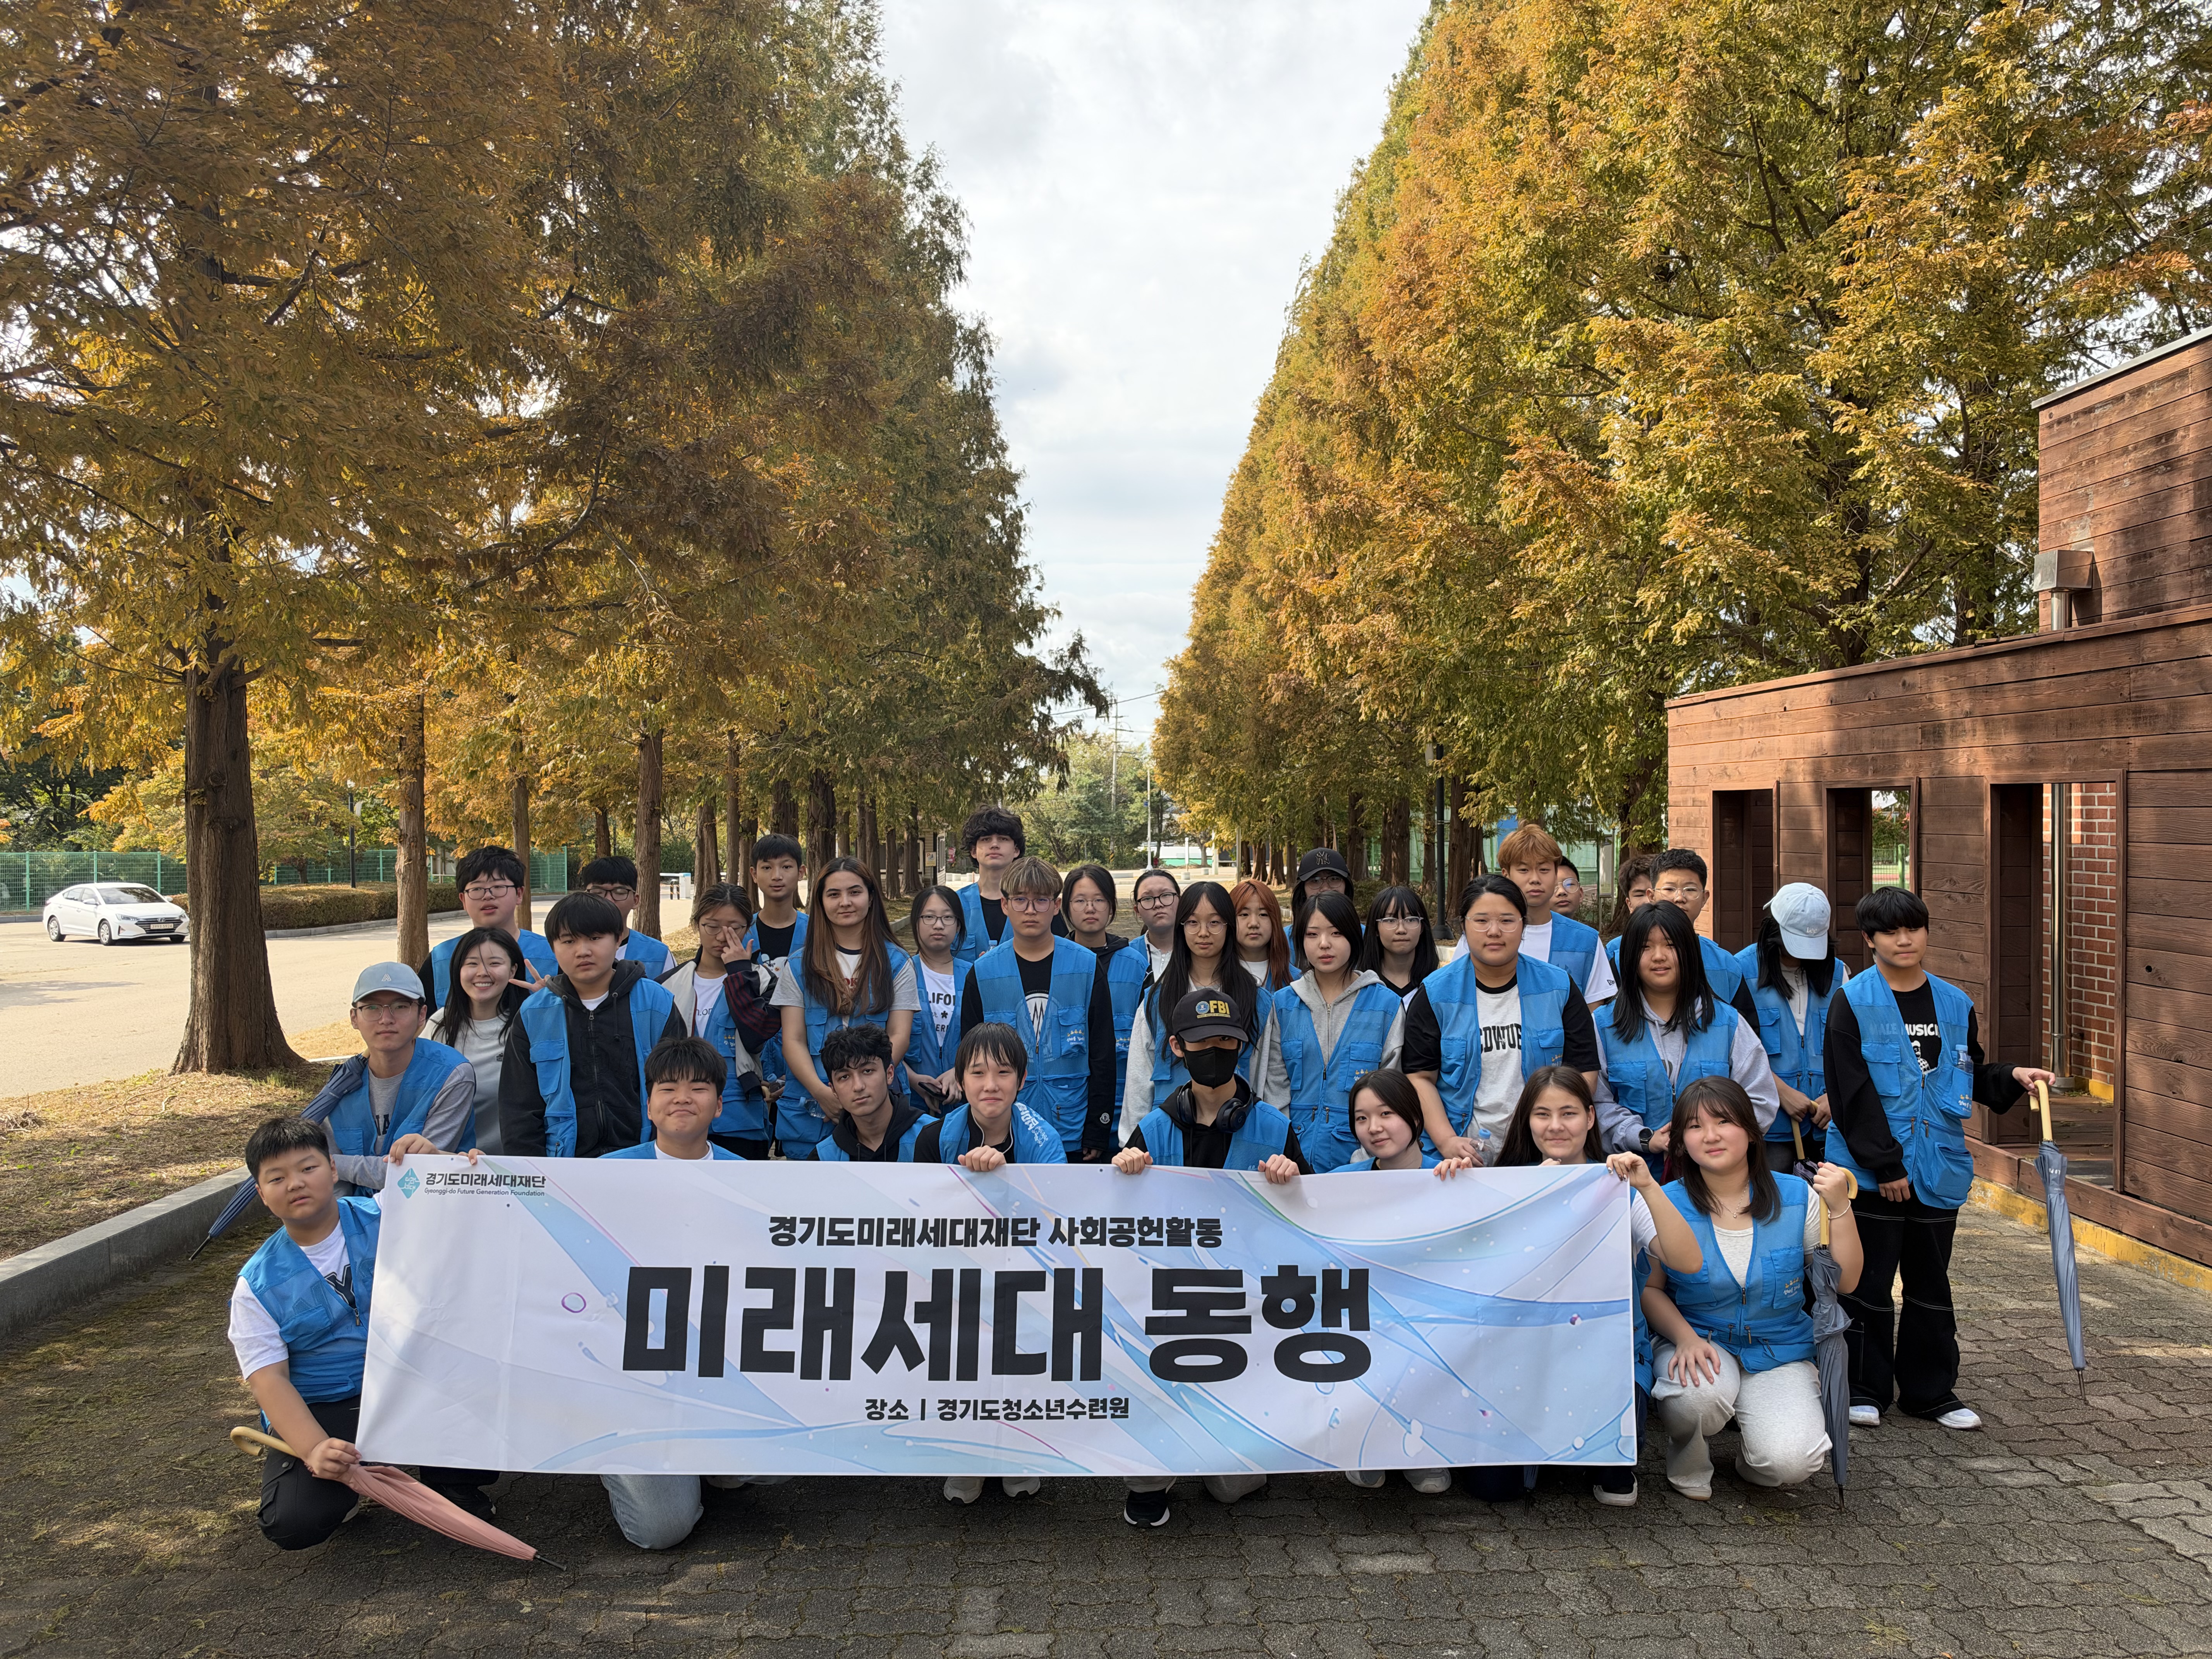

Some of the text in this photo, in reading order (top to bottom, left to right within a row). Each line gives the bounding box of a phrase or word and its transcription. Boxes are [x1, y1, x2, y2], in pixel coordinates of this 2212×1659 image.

[1209, 1000, 1230, 1014] FBI
[426, 1173, 546, 1188] 경기도미래세대재단
[768, 1216, 1223, 1249] 경기도미래세대재단 사회공헌활동
[622, 1264, 1372, 1383] 미래세대 동행
[865, 1399, 909, 1421] 장소
[937, 1397, 1129, 1421] 경기도청소년수련원
